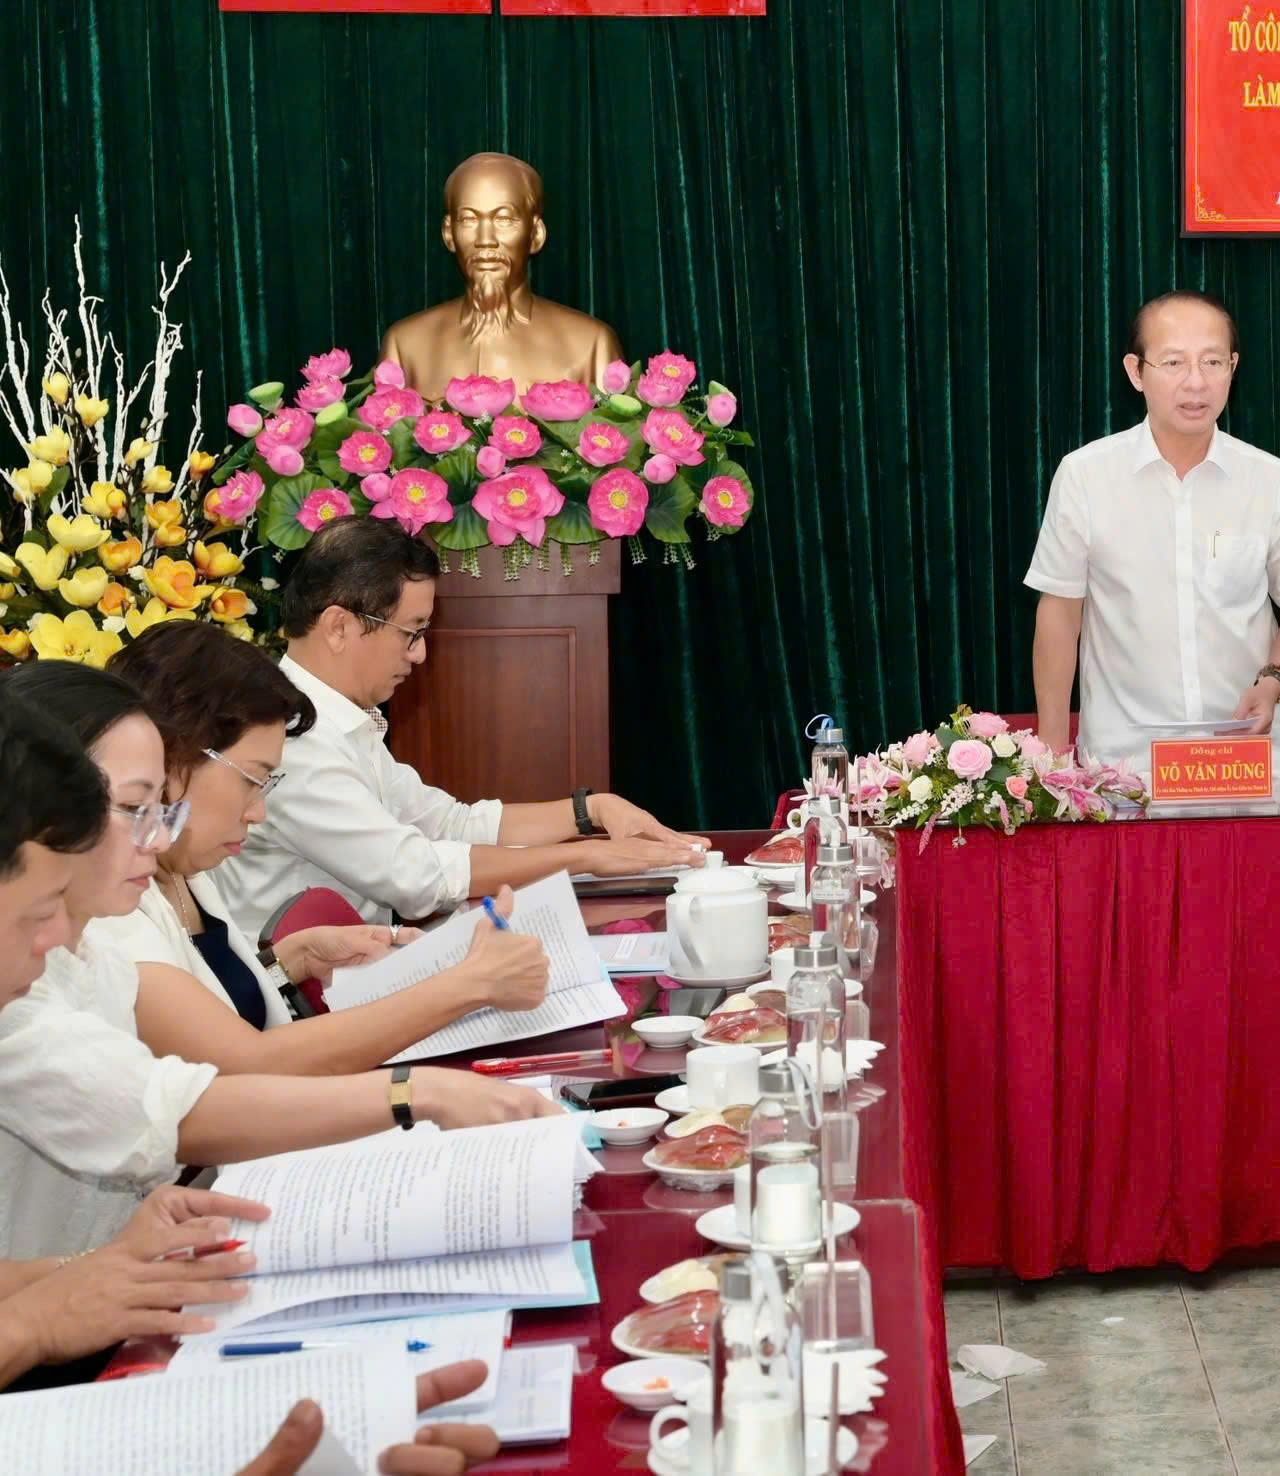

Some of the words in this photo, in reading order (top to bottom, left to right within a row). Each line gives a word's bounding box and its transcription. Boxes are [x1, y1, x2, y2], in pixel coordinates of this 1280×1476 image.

[1229, 6, 1251, 52] TỔ
[1160, 761, 1181, 782] VÕ
[1184, 761, 1217, 781] VĂN
[1221, 759, 1265, 780] DŨNG
